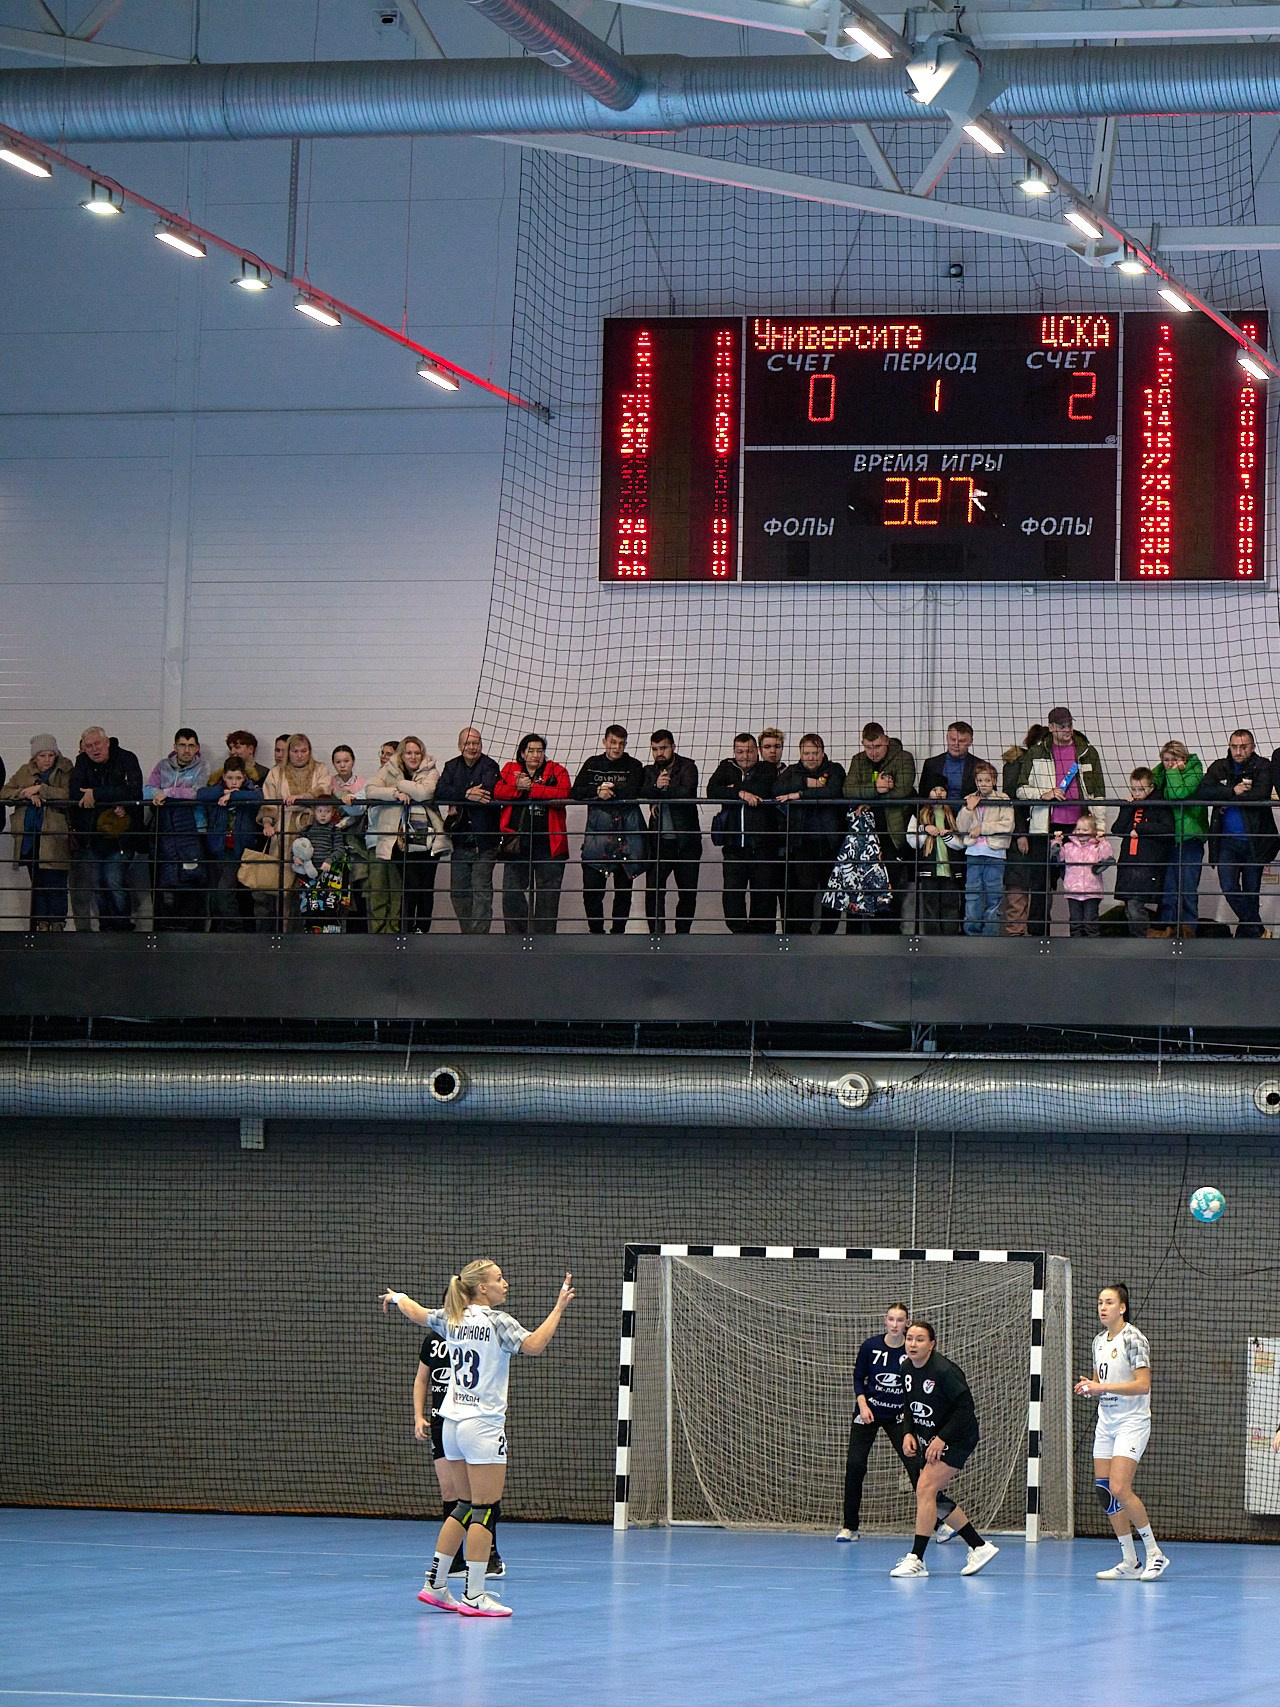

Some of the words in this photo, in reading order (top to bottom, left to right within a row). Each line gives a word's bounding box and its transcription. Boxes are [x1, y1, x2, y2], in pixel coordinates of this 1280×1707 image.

[754, 318, 922, 350] Университе
[1041, 315, 1110, 347] ЦСКА
[766, 353, 835, 372] СЧЕТ
[883, 352, 977, 374] ПЕРИОД
[1026, 351, 1096, 370] СЧЕТ
[808, 373, 836, 422] 0
[934, 379, 941, 412] 1
[1067, 371, 1097, 420] 2
[853, 453, 928, 472] ВРЕМЯ
[941, 453, 1003, 472] ИГРЫ
[763, 517, 835, 536] ФОЛЫ
[1021, 516, 1093, 536] ФОЛЫ
[429, 1339, 449, 1359] 30
[872, 1349, 889, 1367] 71
[452, 1346, 480, 1390] 23
[1098, 1362, 1108, 1380] 67
